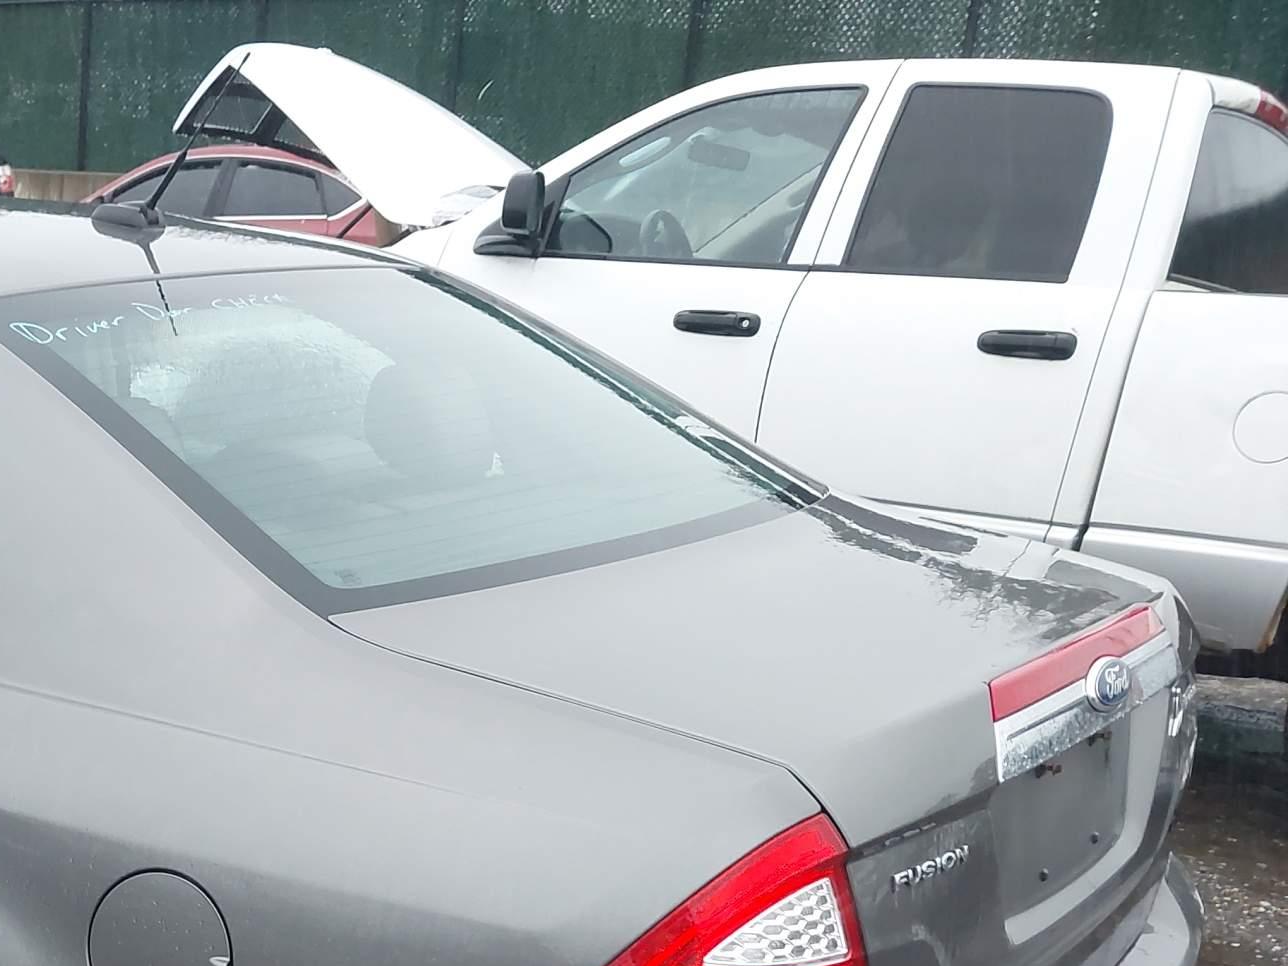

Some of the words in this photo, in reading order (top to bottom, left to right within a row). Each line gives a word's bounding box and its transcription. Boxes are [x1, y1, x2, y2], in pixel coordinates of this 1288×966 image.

[9, 315, 124, 344] Driver
[1104, 664, 1130, 699] Ford
[893, 845, 969, 892] FUSION
